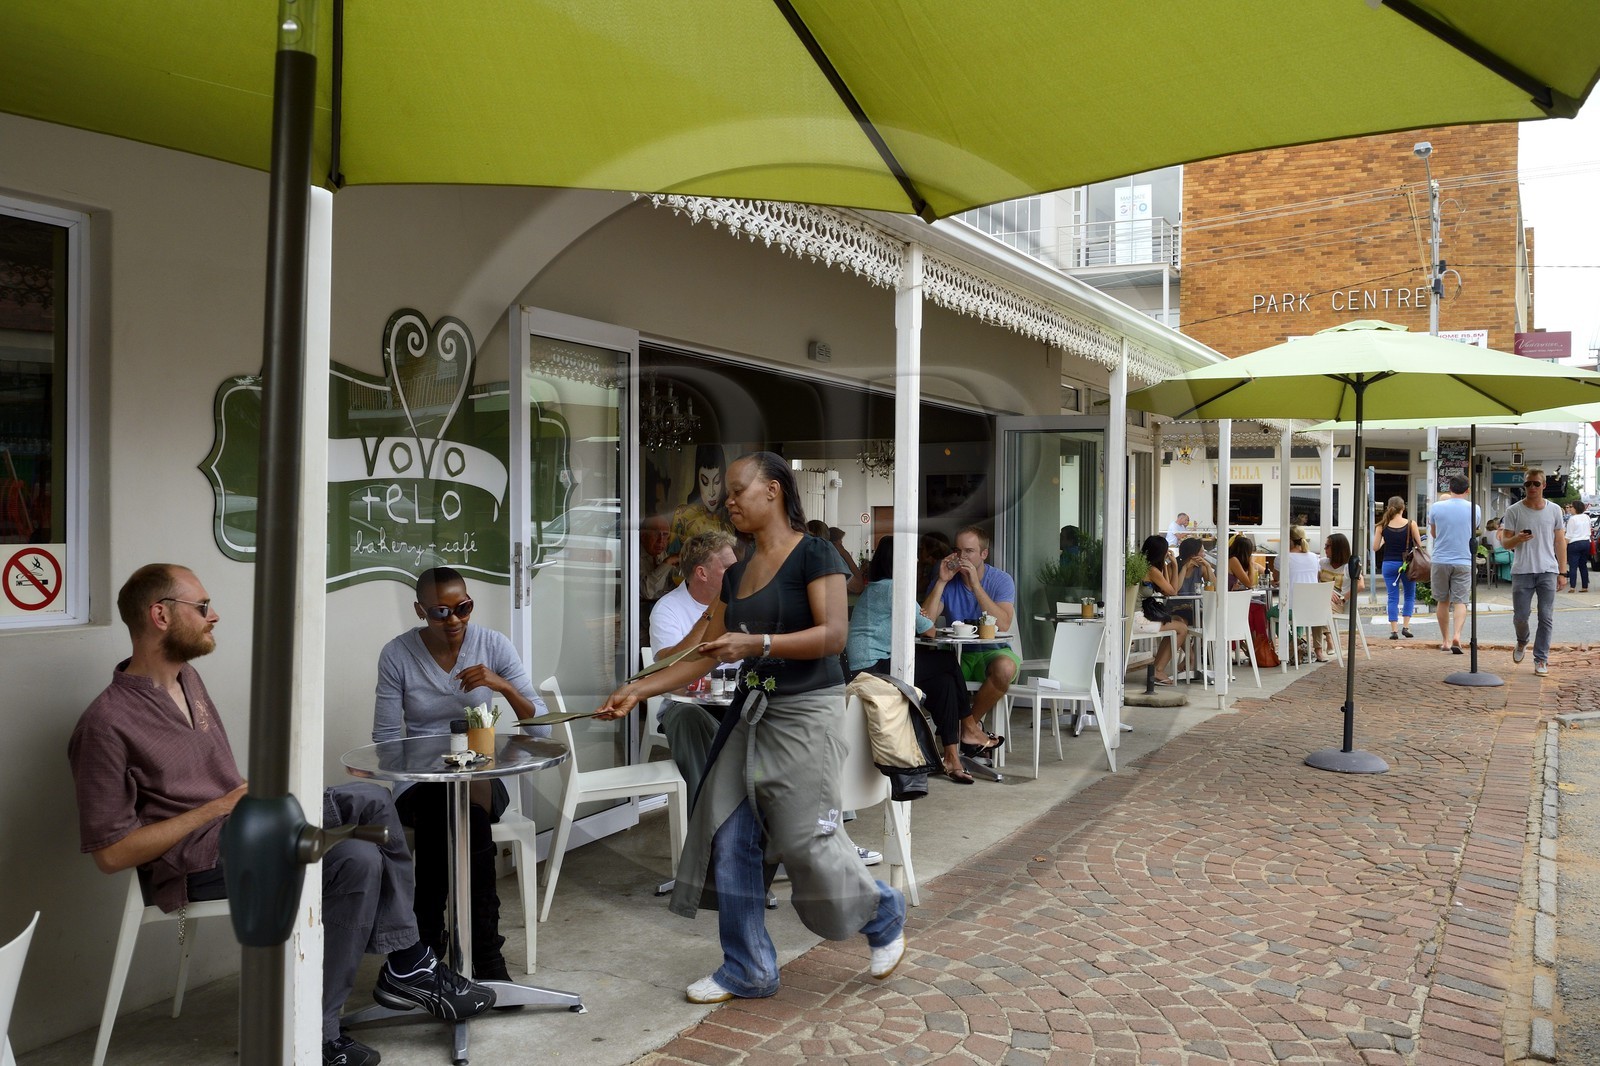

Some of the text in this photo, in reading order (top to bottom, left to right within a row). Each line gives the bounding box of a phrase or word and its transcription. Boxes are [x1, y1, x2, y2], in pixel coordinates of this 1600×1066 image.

[1252, 287, 1427, 314] PARK CENTRE
[1213, 465, 1261, 480] SELLA
[354, 527, 425, 567] bakery
[441, 531, 478, 563] café
